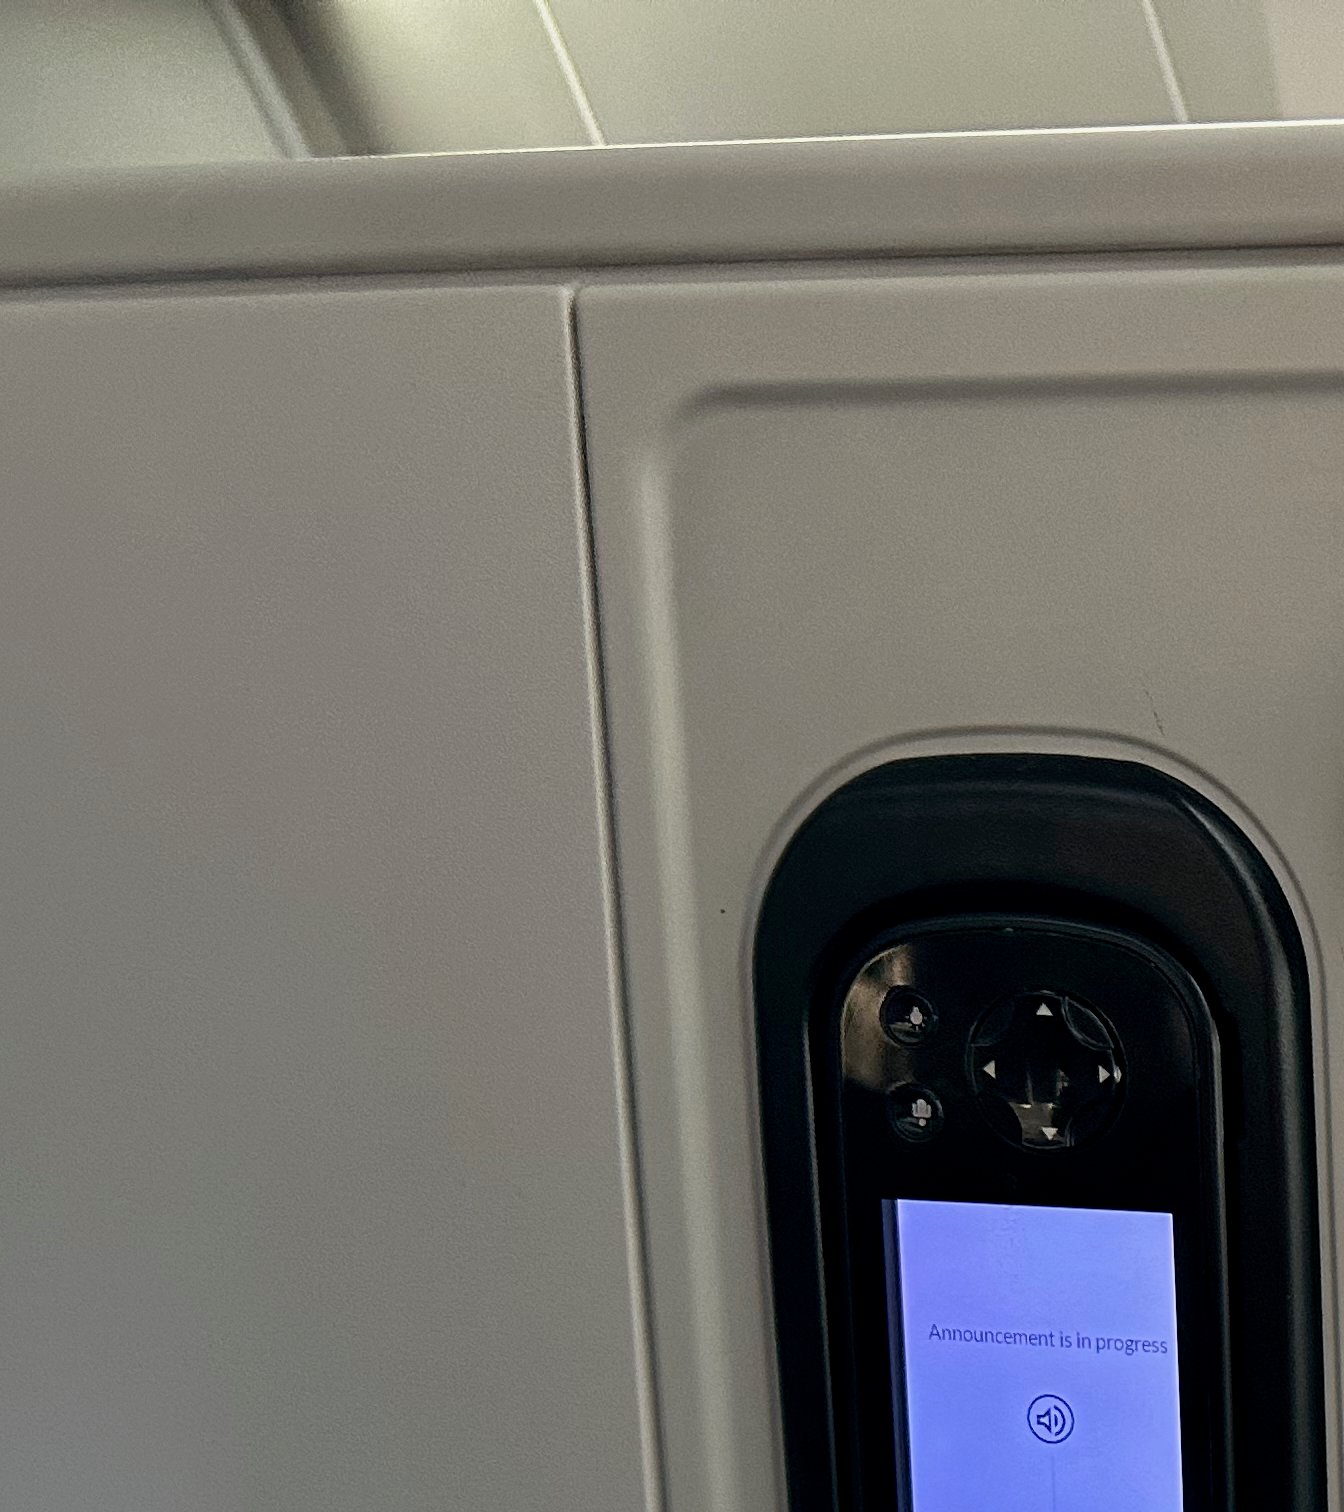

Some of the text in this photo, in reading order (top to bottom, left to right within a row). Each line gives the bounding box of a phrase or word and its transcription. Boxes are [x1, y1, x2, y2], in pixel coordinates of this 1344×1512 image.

[929, 1323, 1169, 1356] Announcement is in progress
